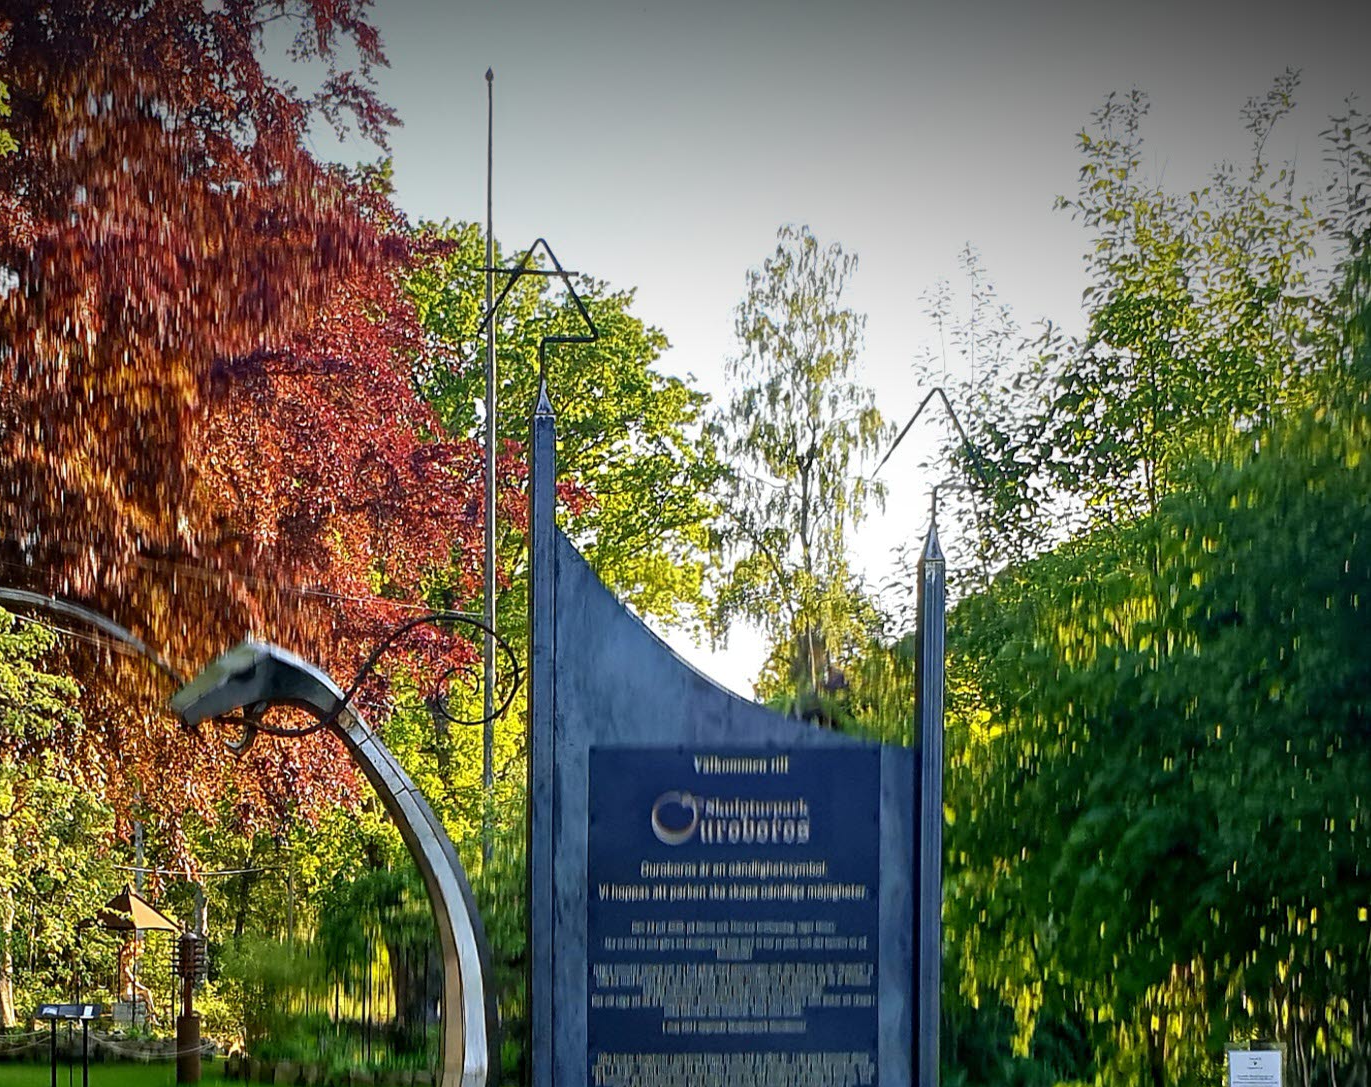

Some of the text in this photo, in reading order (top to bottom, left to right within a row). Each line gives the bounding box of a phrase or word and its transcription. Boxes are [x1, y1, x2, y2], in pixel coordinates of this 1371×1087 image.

[694, 756, 789, 775] Välkommen till
[705, 799, 808, 819] Skulpturpark
